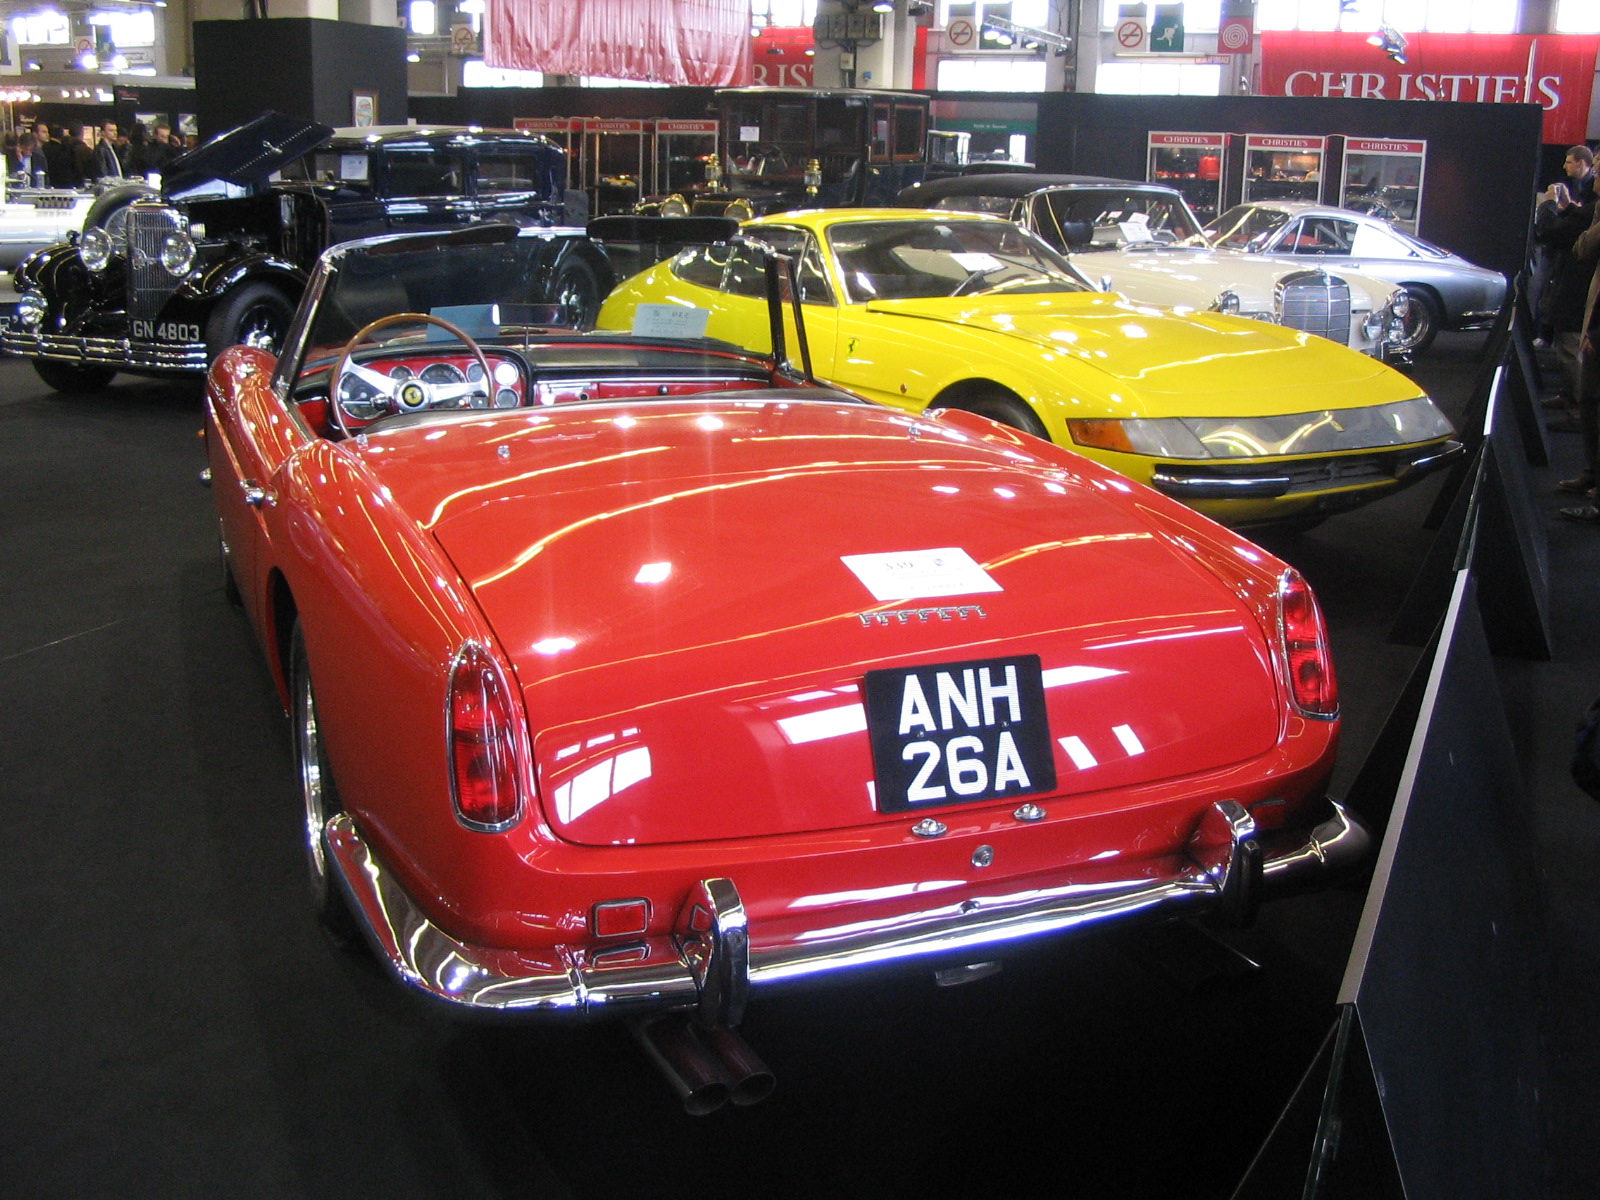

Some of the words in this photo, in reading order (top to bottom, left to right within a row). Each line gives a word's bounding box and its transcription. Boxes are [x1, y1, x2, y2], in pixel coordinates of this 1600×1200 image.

[1261, 138, 1309, 147] CHRISTIE'S
[1360, 142, 1408, 151] CHRISTIE'S
[133, 320, 154, 338] GN
[157, 322, 200, 342] 4803
[899, 665, 1022, 735] ANH
[902, 731, 1031, 802] 26A
